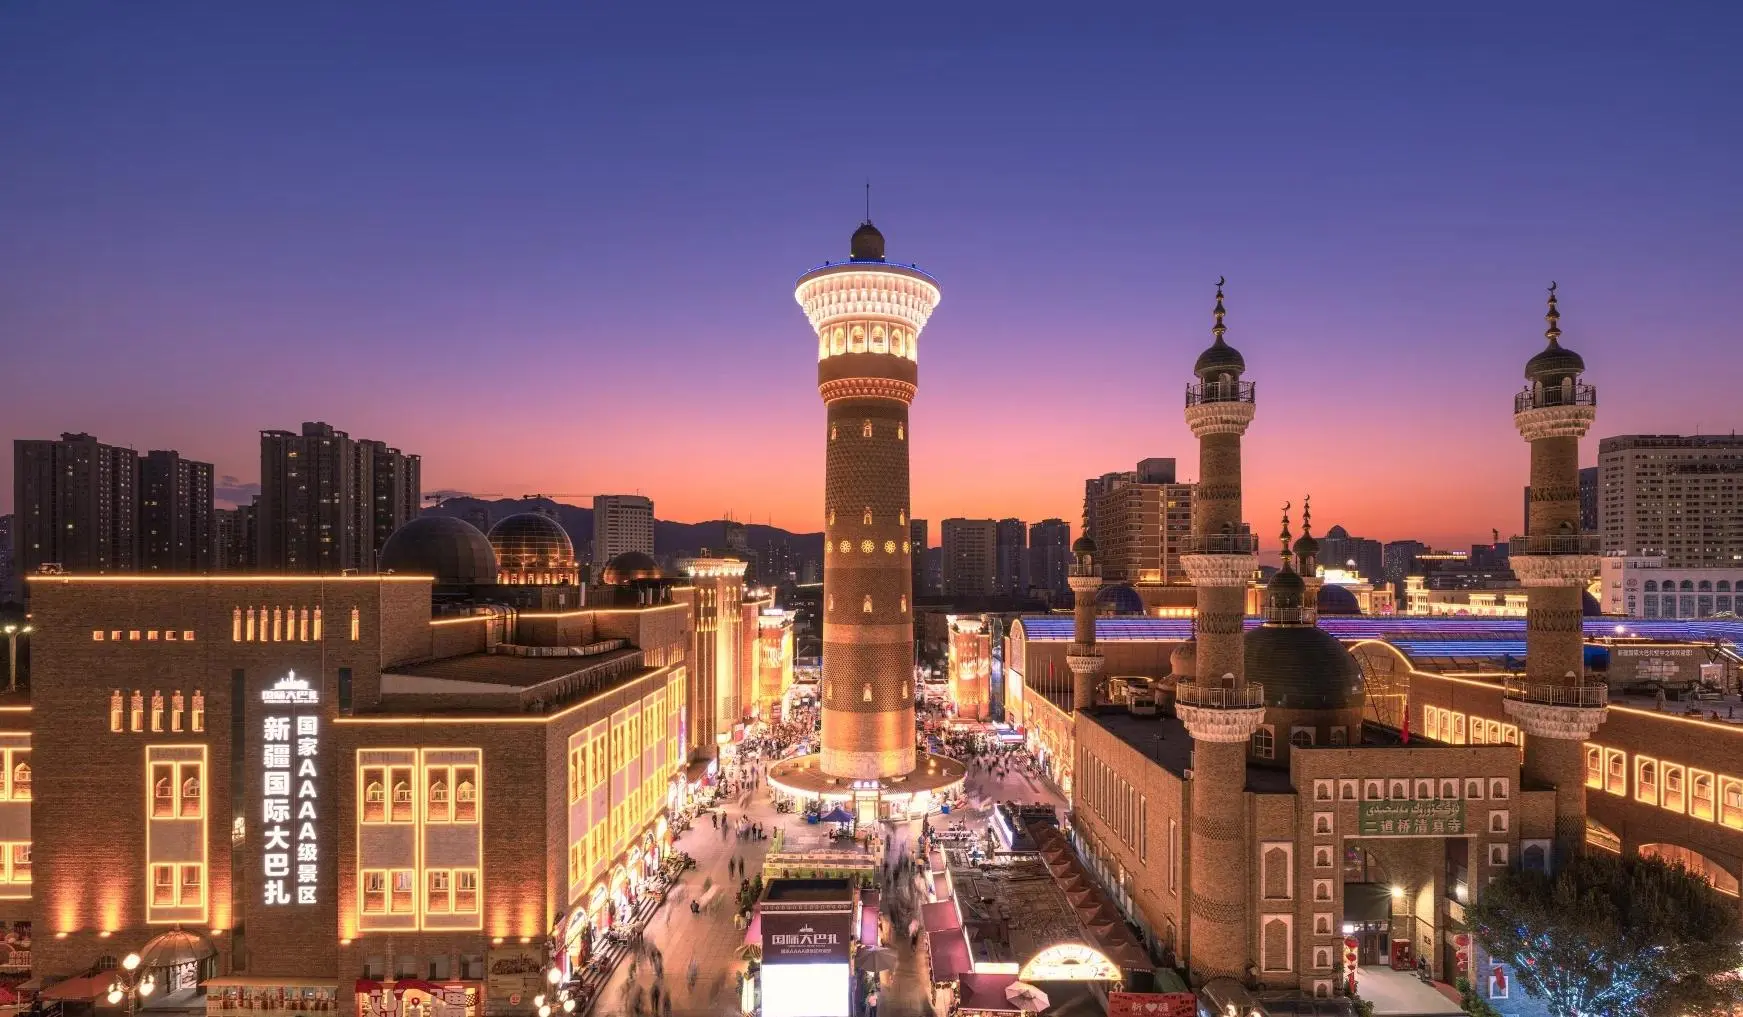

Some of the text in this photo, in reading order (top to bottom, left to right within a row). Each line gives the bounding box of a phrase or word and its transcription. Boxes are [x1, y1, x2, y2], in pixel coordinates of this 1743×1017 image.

[263, 716, 291, 905] 新疆国际大巴扎
[297, 716, 318, 905] 国家AAAA级景区
[1364, 819, 1461, 833] 二道桥清真寺
[772, 933, 840, 945] 国际大巴扎
